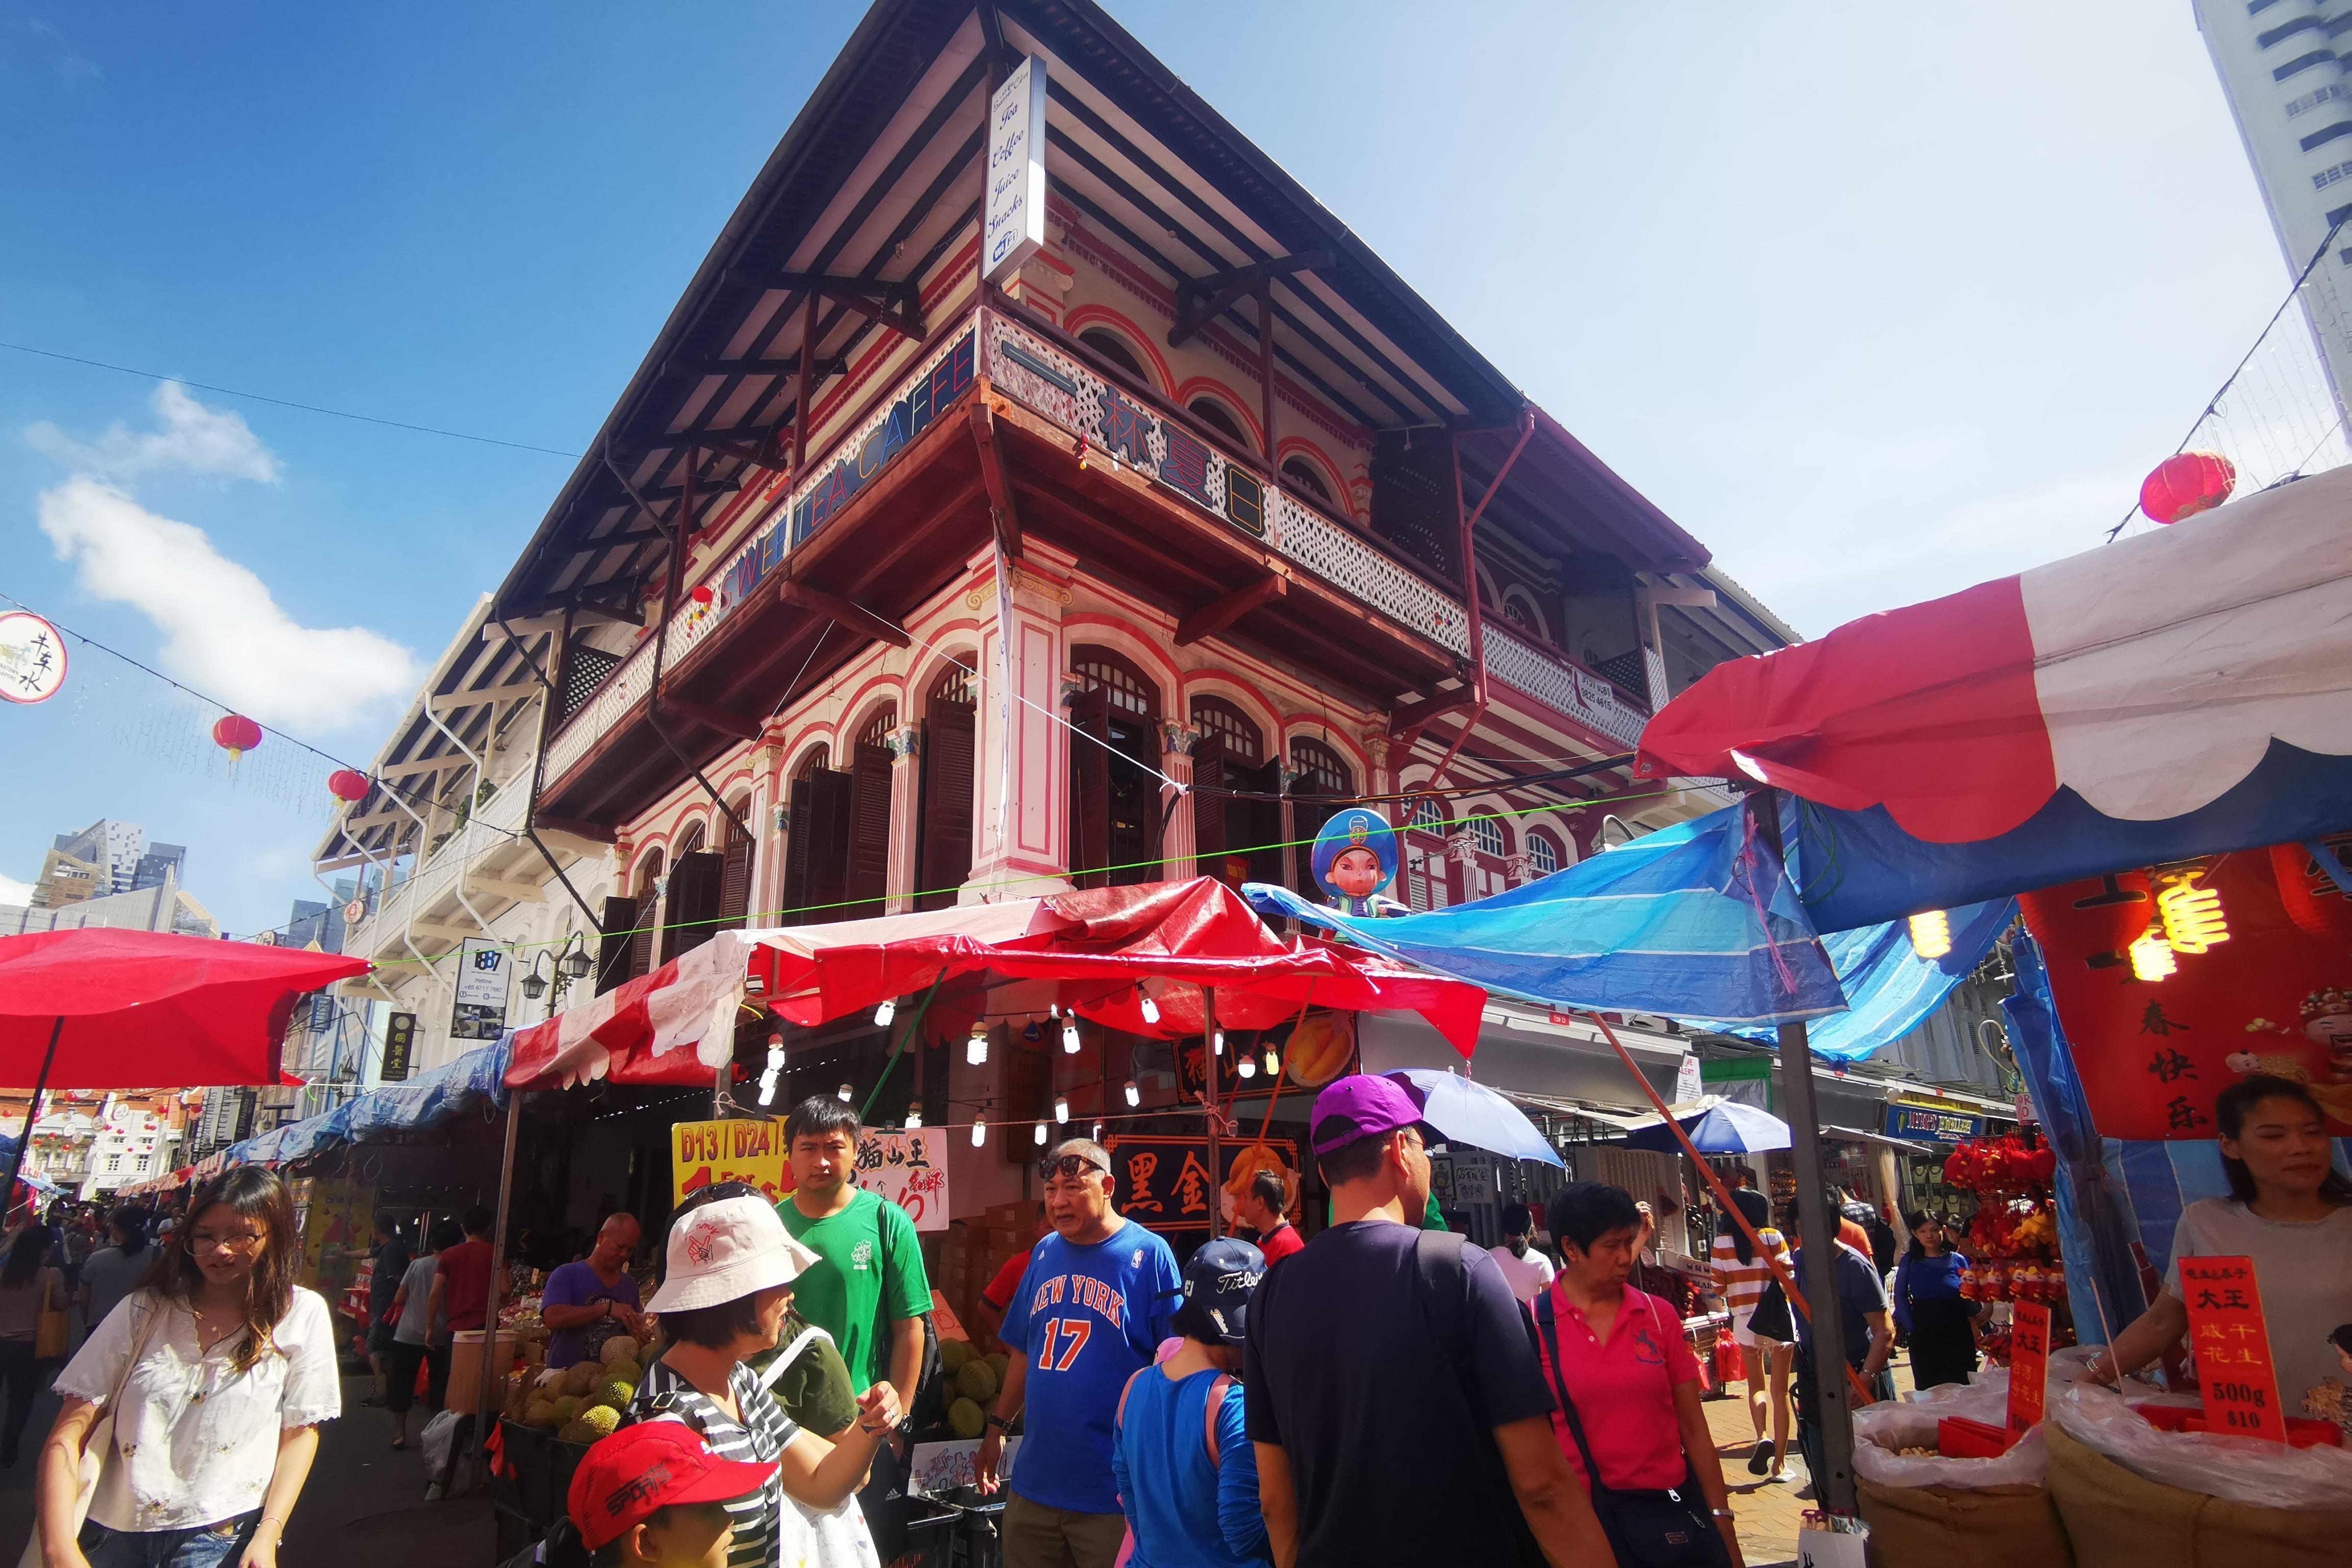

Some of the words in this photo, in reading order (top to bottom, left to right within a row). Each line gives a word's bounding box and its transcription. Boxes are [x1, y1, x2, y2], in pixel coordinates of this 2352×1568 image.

[999, 102, 1018, 131] Tea
[992, 129, 1025, 168] Coffee
[993, 168, 1021, 207] Juice
[988, 194, 1023, 239] Snacks
[795, 467, 847, 542] TEA
[859, 337, 971, 479] CAFFE
[1004, 343, 1263, 532] 一杯夏日
[19, 631, 52, 692] 牛车水
[681, 1125, 718, 1163] D13
[734, 1121, 770, 1158] D24
[855, 1138, 930, 1170] 猫山王
[1120, 1150, 1210, 1214] 黑金
[1030, 1275, 1068, 1319] NEW
[1071, 1275, 1125, 1330] YORK
[2197, 1289, 2249, 1310] 大王
[1038, 1317, 1091, 1371] 17
[2016, 1330, 2041, 1356] 大王
[2200, 1322, 2257, 1340] 咸干
[2203, 1346, 2262, 1365] 花生
[2212, 1381, 2266, 1409] 500g
[2227, 1409, 2260, 1429] $10
